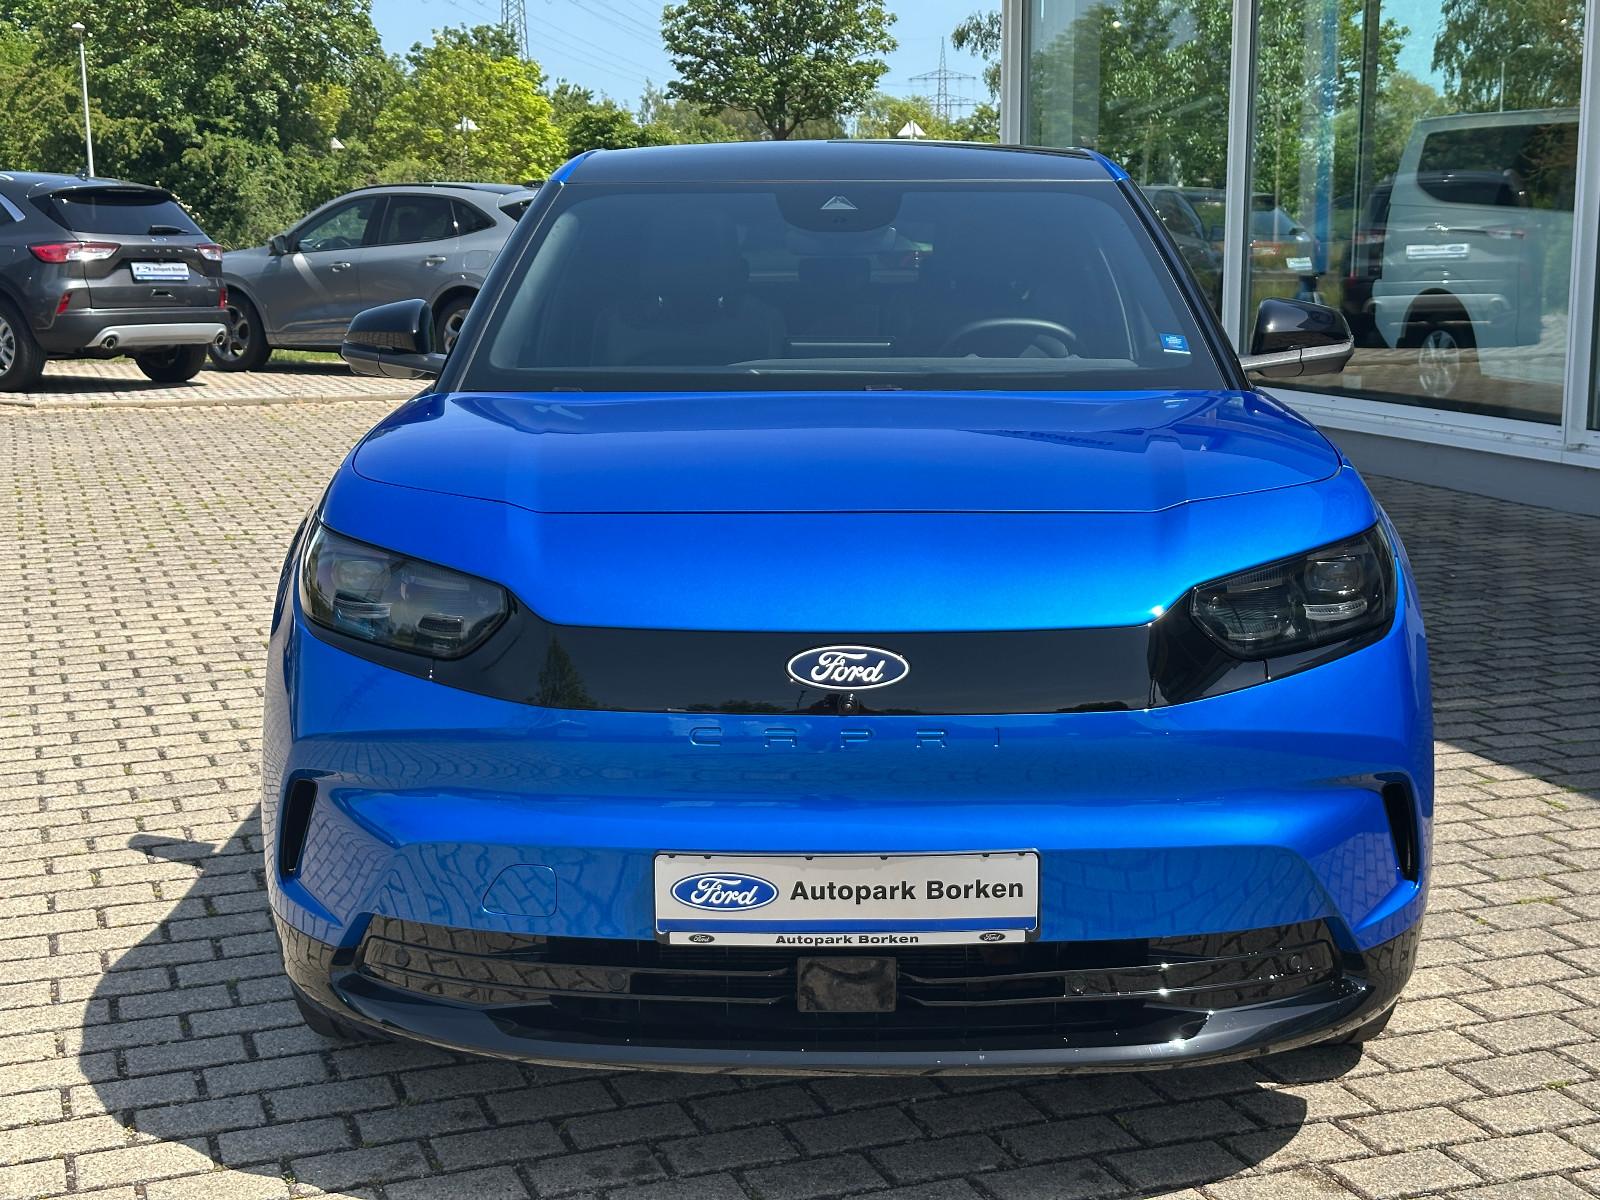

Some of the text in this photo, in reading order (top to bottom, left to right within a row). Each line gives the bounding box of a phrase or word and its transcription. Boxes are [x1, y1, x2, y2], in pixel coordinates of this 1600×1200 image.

[810, 651, 885, 682] Ford
[689, 727, 1000, 749] CAPRI
[690, 877, 1024, 906] Ford Autopark Borken
[692, 933, 1001, 947] Ford Autopark Borken Ford
